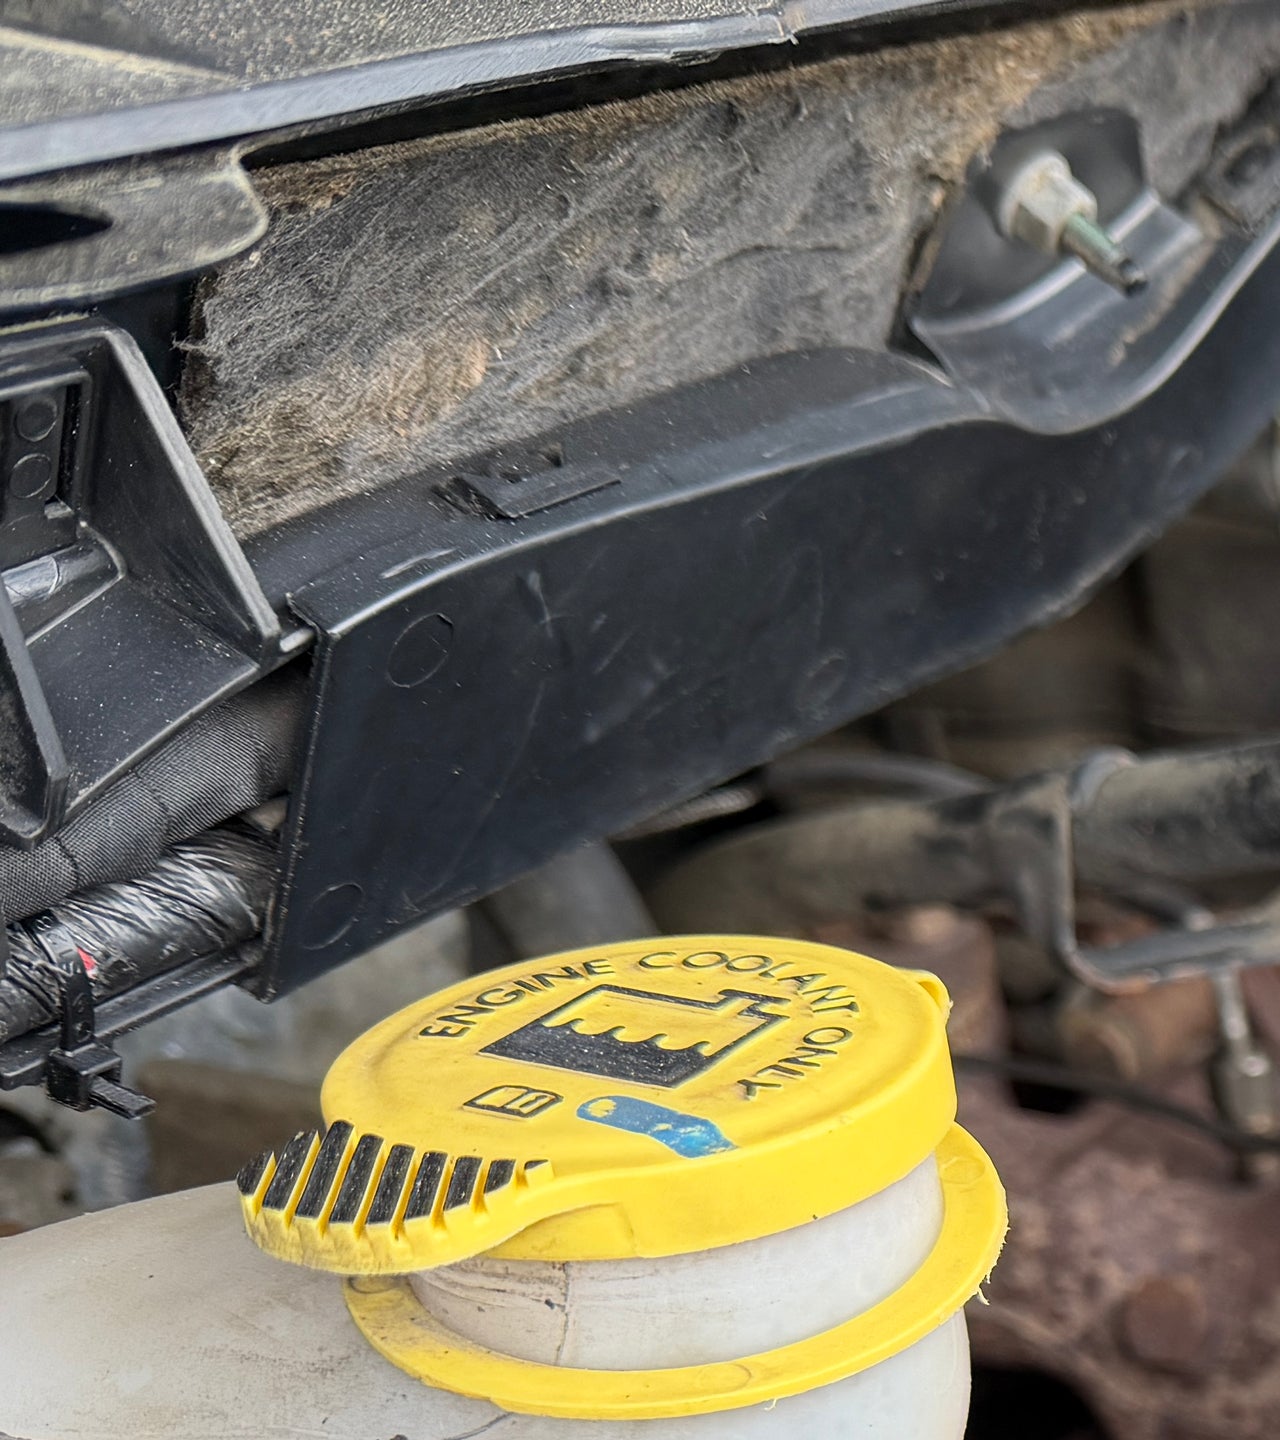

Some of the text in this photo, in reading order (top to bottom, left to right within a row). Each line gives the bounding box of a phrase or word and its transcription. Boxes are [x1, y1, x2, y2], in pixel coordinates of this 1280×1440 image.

[418, 950, 861, 1101] ENGINE COOLANT ONLY
